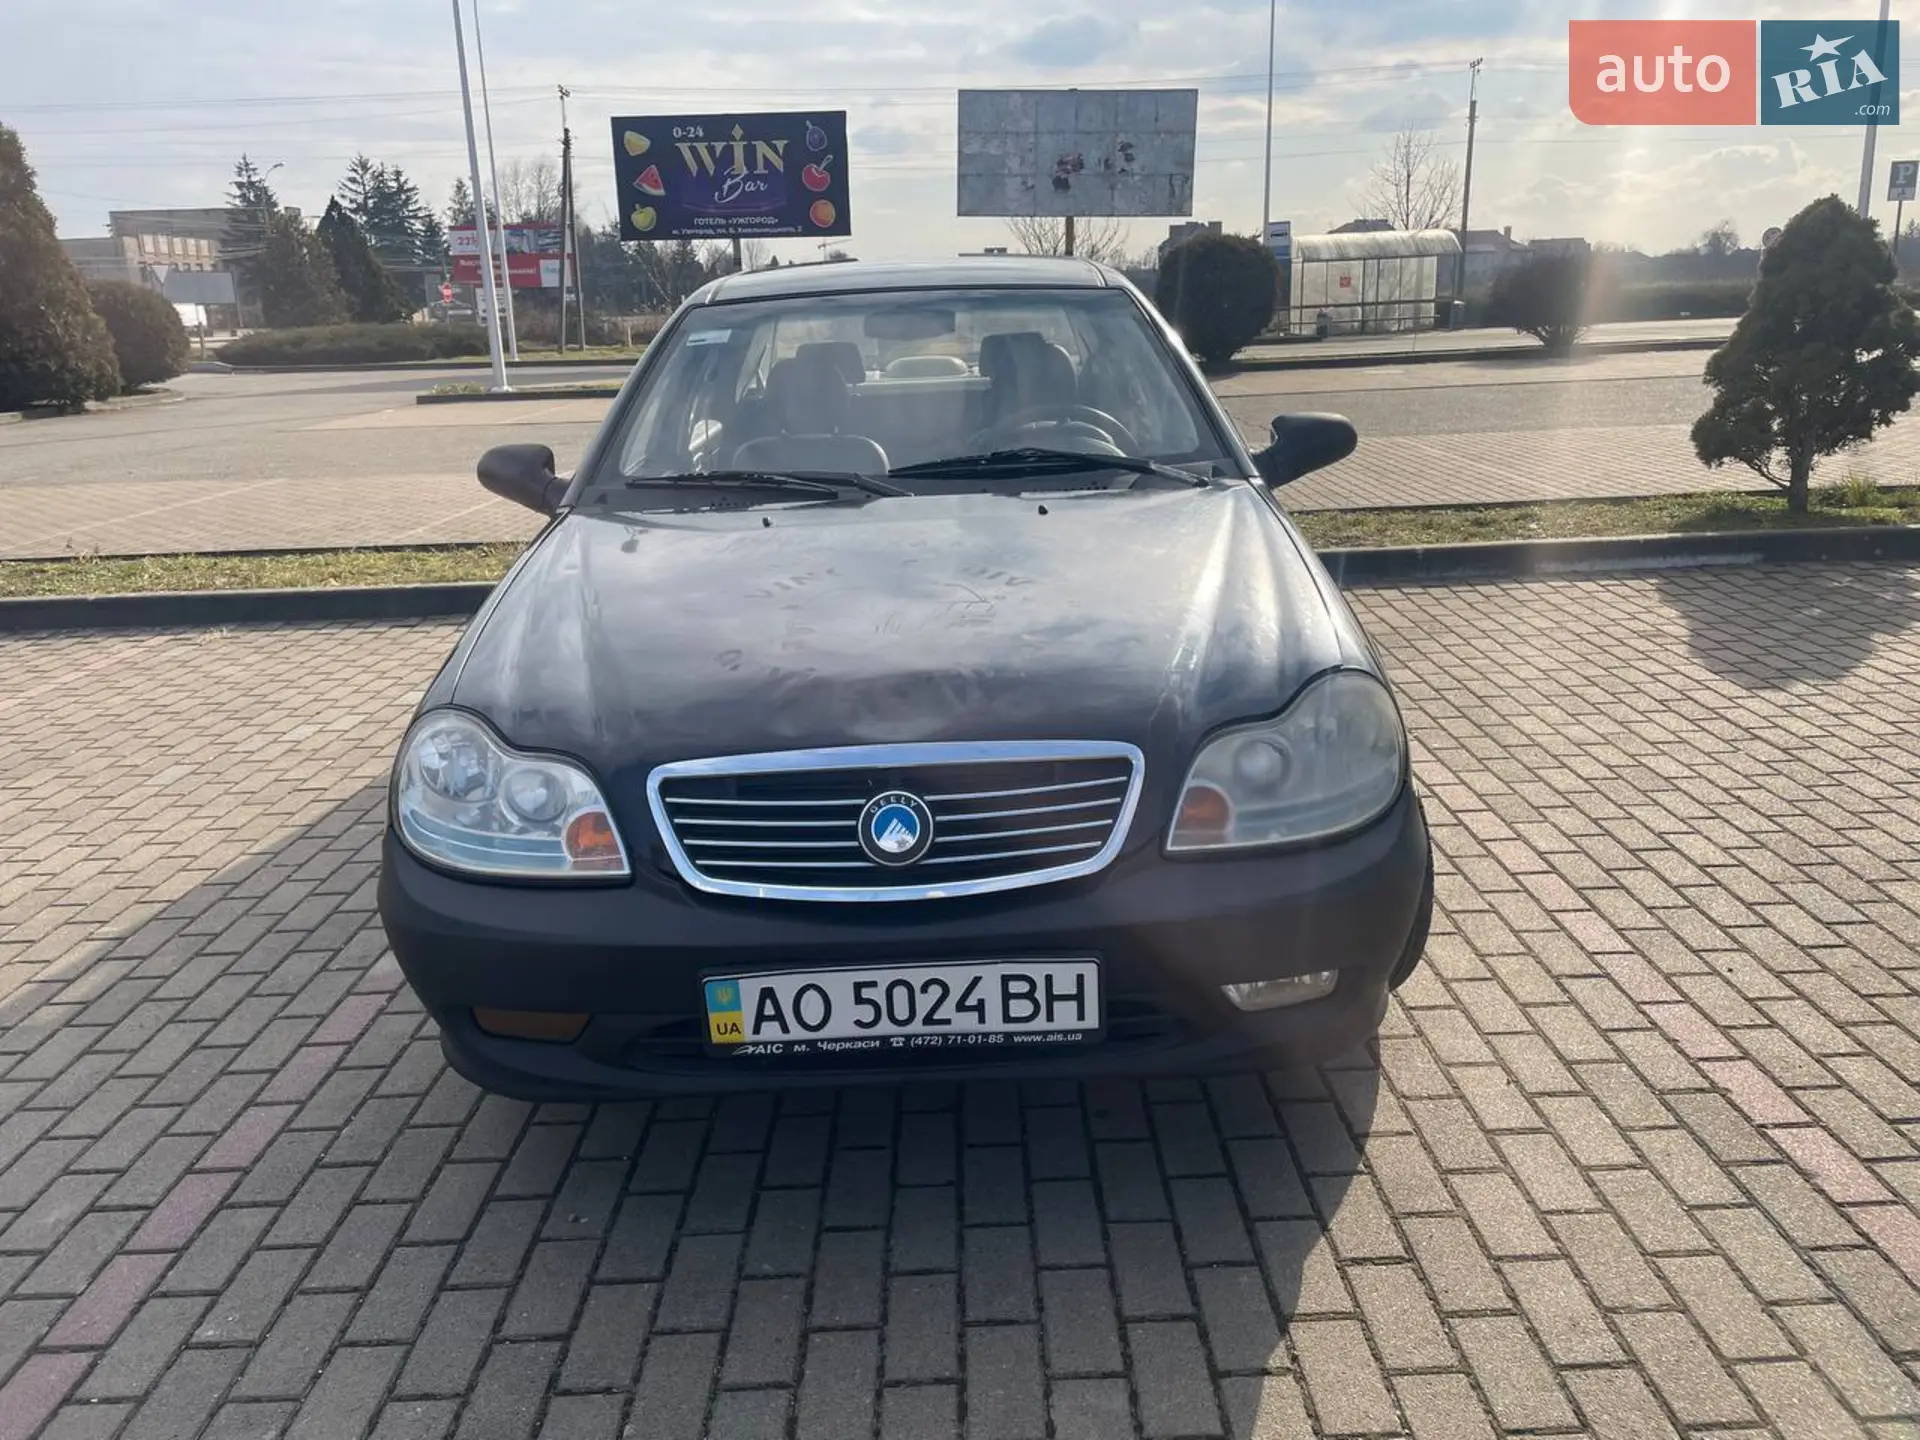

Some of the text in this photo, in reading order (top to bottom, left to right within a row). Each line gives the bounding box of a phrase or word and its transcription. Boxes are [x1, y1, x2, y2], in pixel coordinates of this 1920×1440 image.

[673, 125, 704, 138] 0-24
[1895, 163, 1914, 184] P
[714, 165, 768, 203] Bar
[752, 973, 1085, 1036] AO 5024 BH
[716, 1021, 742, 1036] UA
[817, 1039, 880, 1052] Черкаси
[911, 1035, 942, 1047] (472)
[947, 1034, 1004, 1045] 71-01-85
[1013, 1032, 1082, 1043] www.ais.ua
